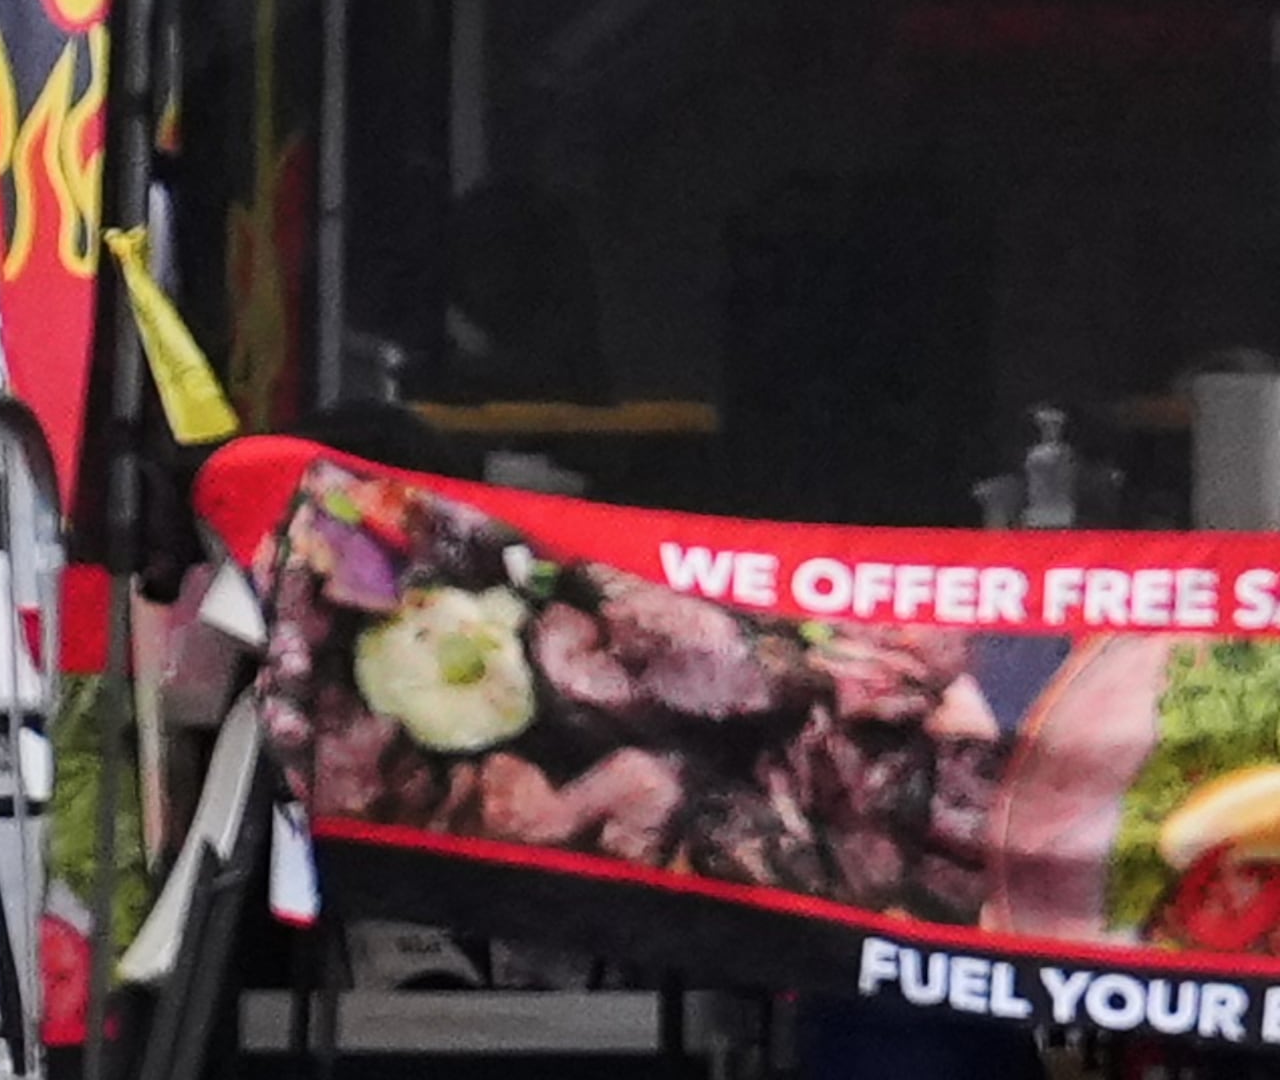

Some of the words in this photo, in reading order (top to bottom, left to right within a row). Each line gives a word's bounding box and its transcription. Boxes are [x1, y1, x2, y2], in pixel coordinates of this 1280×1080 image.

[660, 542, 779, 607] WE
[792, 557, 1028, 624] OFFER
[1043, 567, 1219, 628] FREE
[1233, 568, 1280, 630] S
[858, 936, 1033, 1019] FUEL
[1041, 966, 1250, 1042] YOUR
